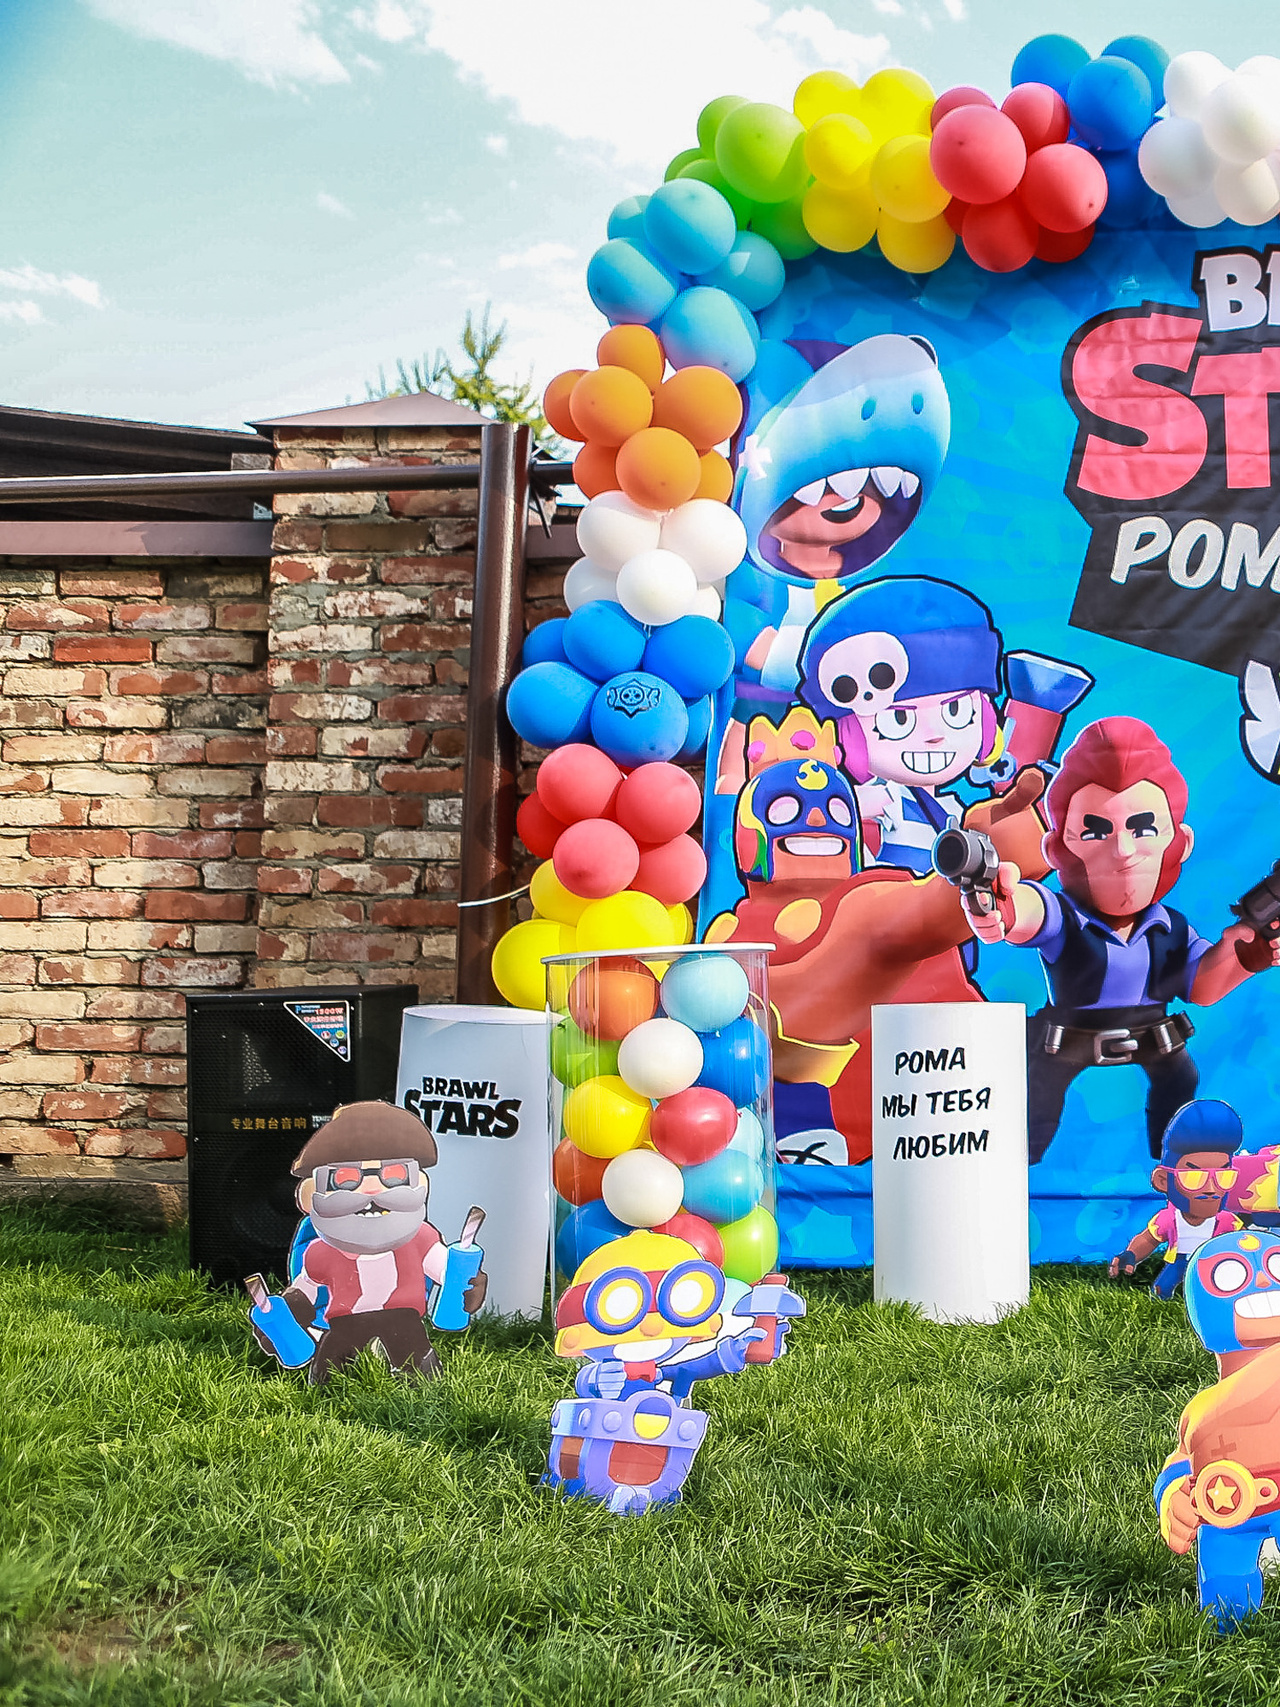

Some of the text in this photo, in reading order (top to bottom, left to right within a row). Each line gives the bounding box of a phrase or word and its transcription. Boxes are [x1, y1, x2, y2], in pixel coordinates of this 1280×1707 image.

[894, 1046, 966, 1076] РОМА
[422, 1076, 500, 1100] BRAWL
[882, 1087, 991, 1119] МЫ ТЕБЯ
[231, 1117, 307, 1130] 专业舞台音响
[893, 1129, 989, 1160] ЛЮБИМ
